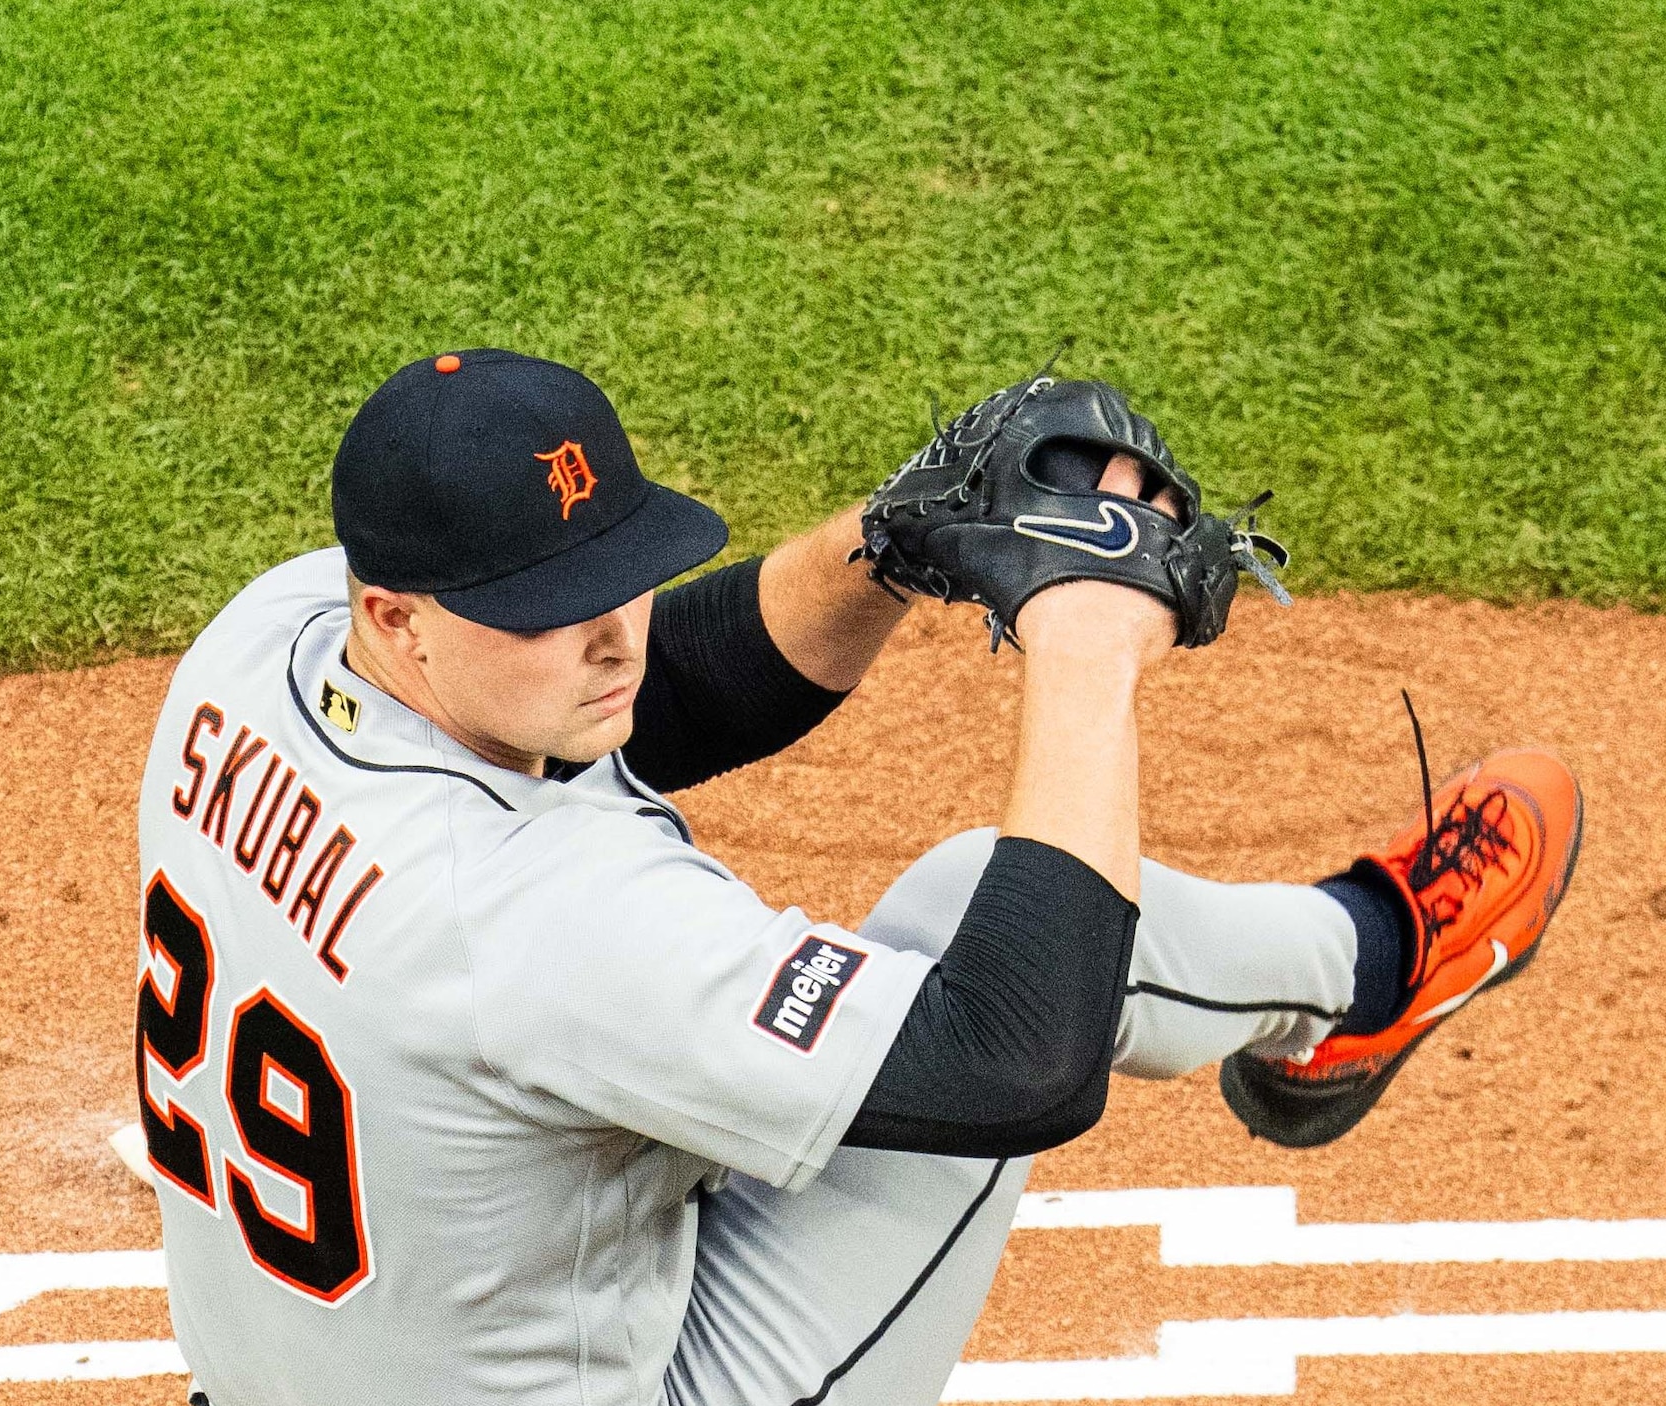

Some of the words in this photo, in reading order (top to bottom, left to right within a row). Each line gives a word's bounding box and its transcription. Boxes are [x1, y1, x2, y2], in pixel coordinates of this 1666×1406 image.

[534, 440, 598, 520] D
[171, 701, 385, 986] SKUBAL
[772, 944, 848, 1039] meijer
[133, 867, 378, 1310] 29
